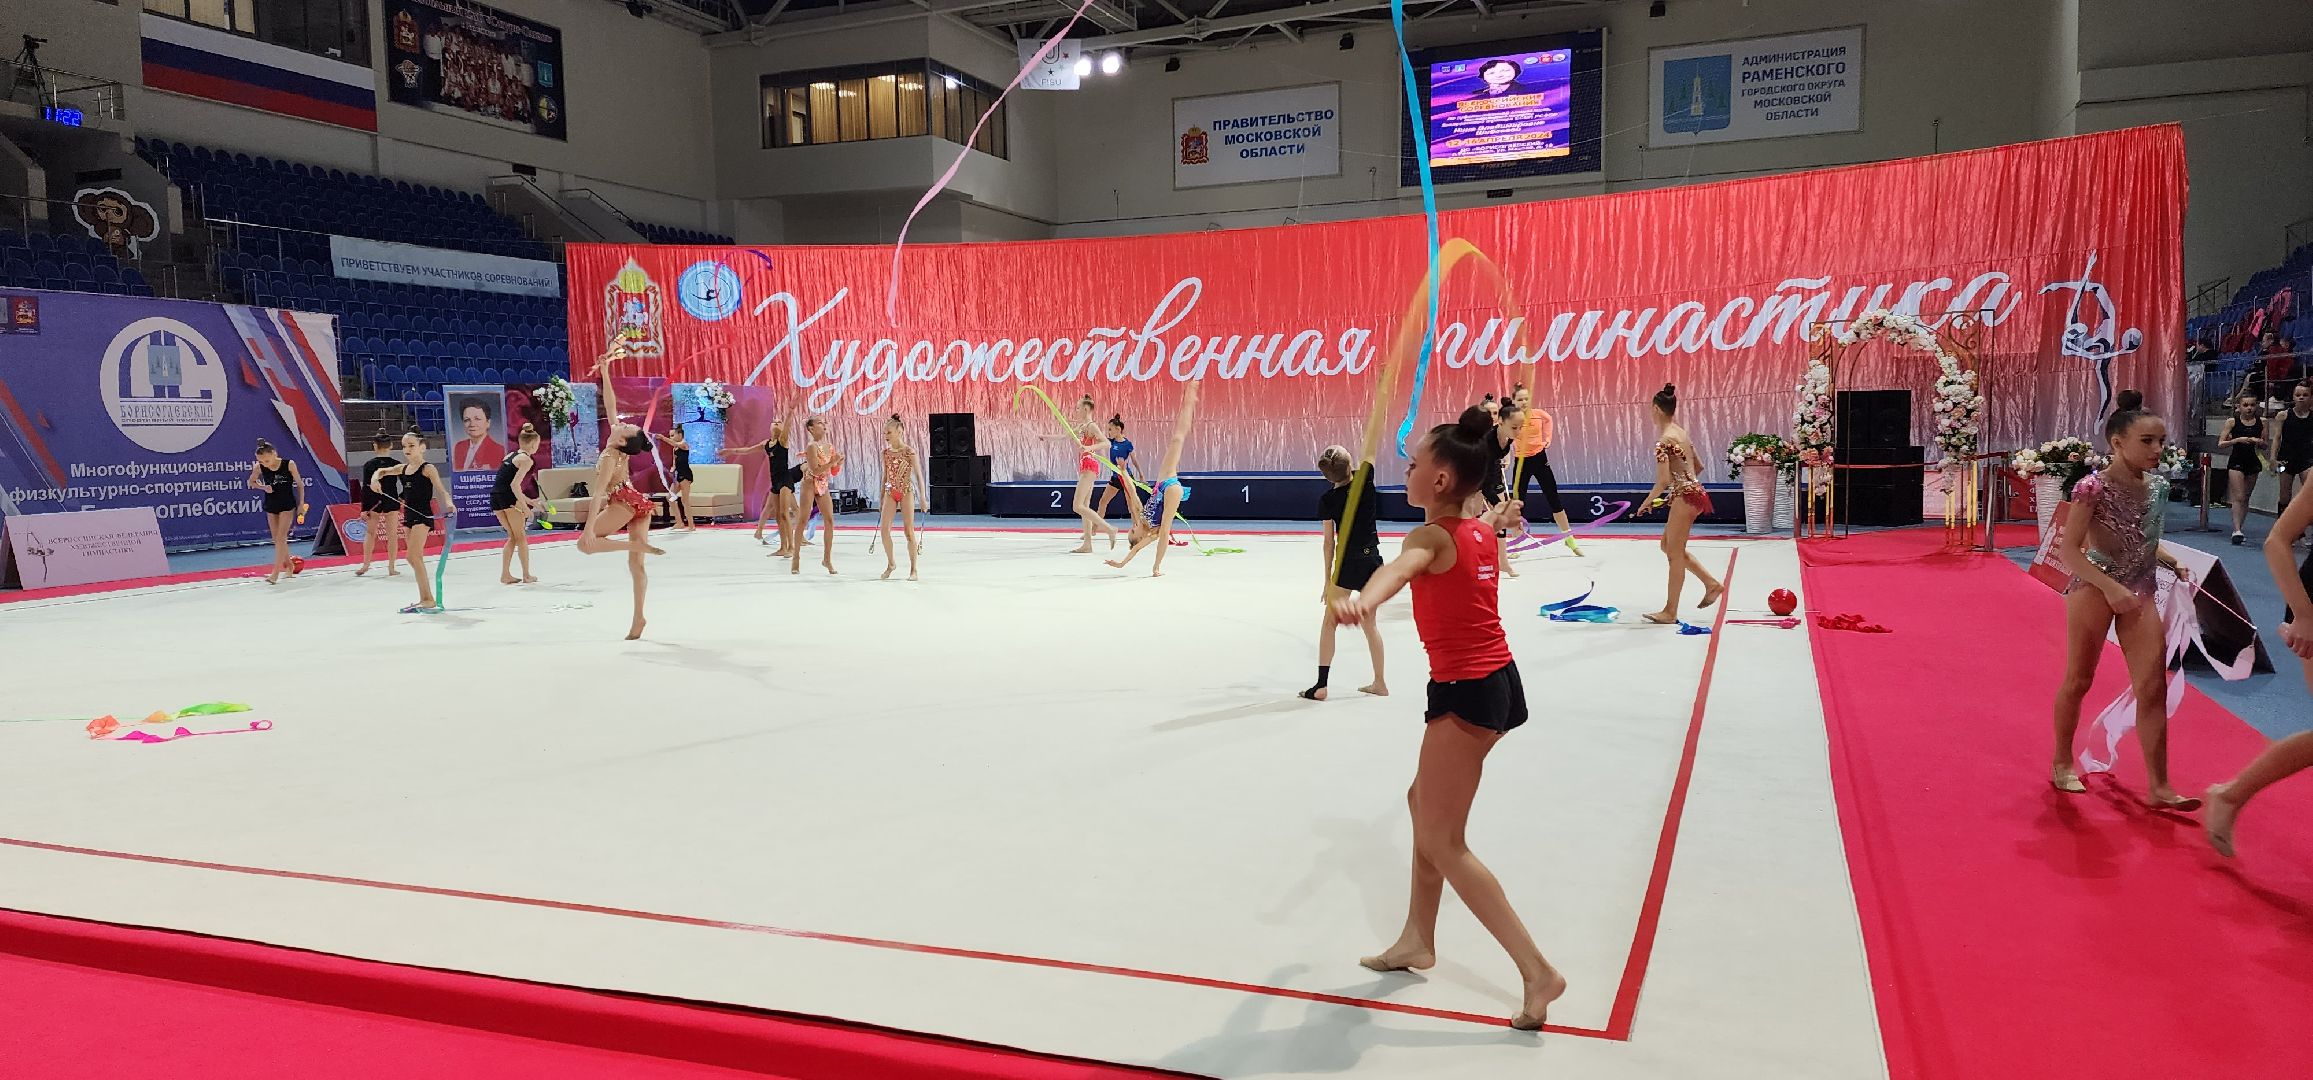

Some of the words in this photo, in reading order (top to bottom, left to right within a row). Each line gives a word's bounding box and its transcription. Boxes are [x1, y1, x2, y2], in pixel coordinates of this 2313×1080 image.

[1741, 46, 1846, 66] АДМИНИСТРАЦИЯ
[1741, 62, 1846, 83] РАМЕНСКОГО
[1741, 82, 1807, 97] ГОРОДСКОГО
[1807, 79, 1845, 90] ОКРУГА
[1753, 91, 1832, 109] МОСКОВСКОЙ
[1213, 109, 1335, 131] ПРАВИТЕЛЬСТВО
[1765, 107, 1819, 121] ОБЛАСТИ
[1224, 124, 1321, 145] МОСКОВСКОЙ
[1239, 143, 1305, 159] ОБЛАСТИ
[341, 257, 420, 276] ПРИВЕТСТВУЕМ
[421, 265, 483, 282] УЧАСТНИКОВ
[744, 277, 1375, 415] Художественная
[1436, 271, 2022, 368] гимнастика
[70, 460, 258, 479] Многофункциональны
[9, 476, 243, 503] физкультурно-спортивный
[1050, 491, 1062, 507] 2
[1241, 485, 1249, 502] 1
[1590, 495, 1605, 516] 3
